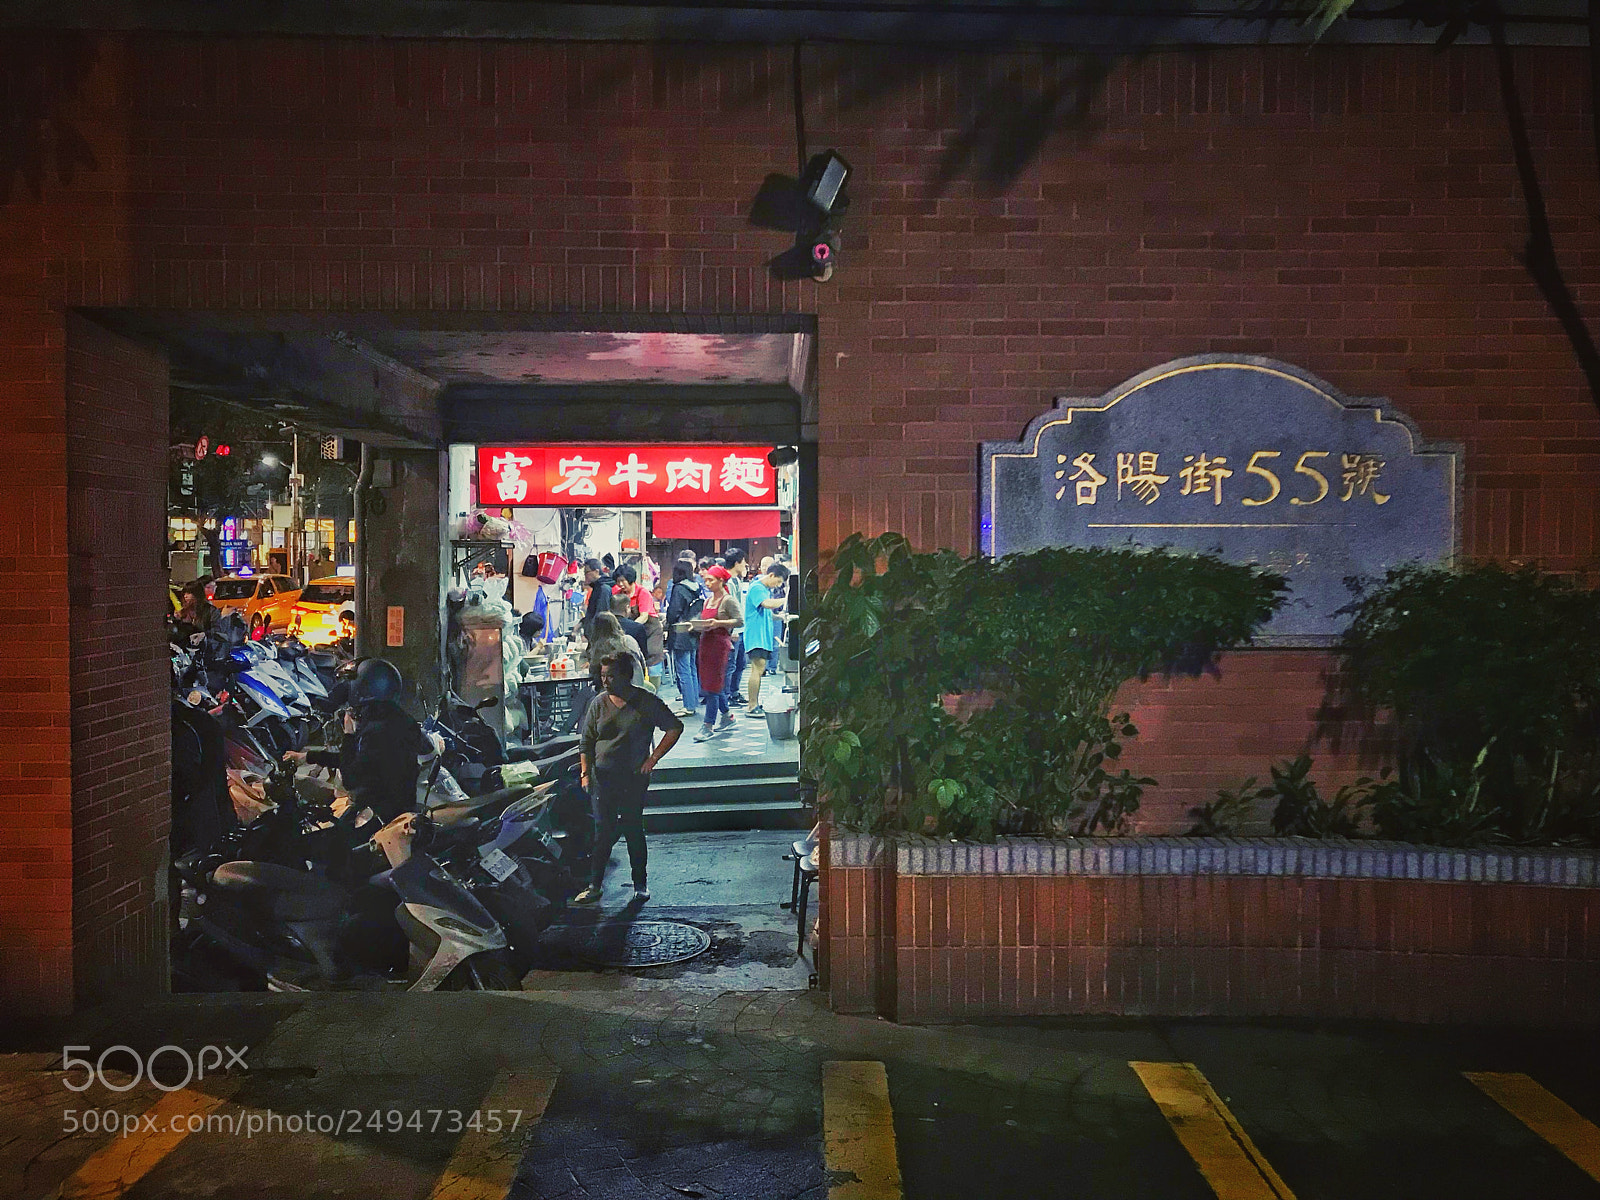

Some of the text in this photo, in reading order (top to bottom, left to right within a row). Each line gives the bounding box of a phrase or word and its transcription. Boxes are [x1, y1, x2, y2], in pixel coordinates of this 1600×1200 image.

[492, 452, 770, 502] 富宏牛肉麵
[1055, 451, 1391, 506] 洛陽街55號
